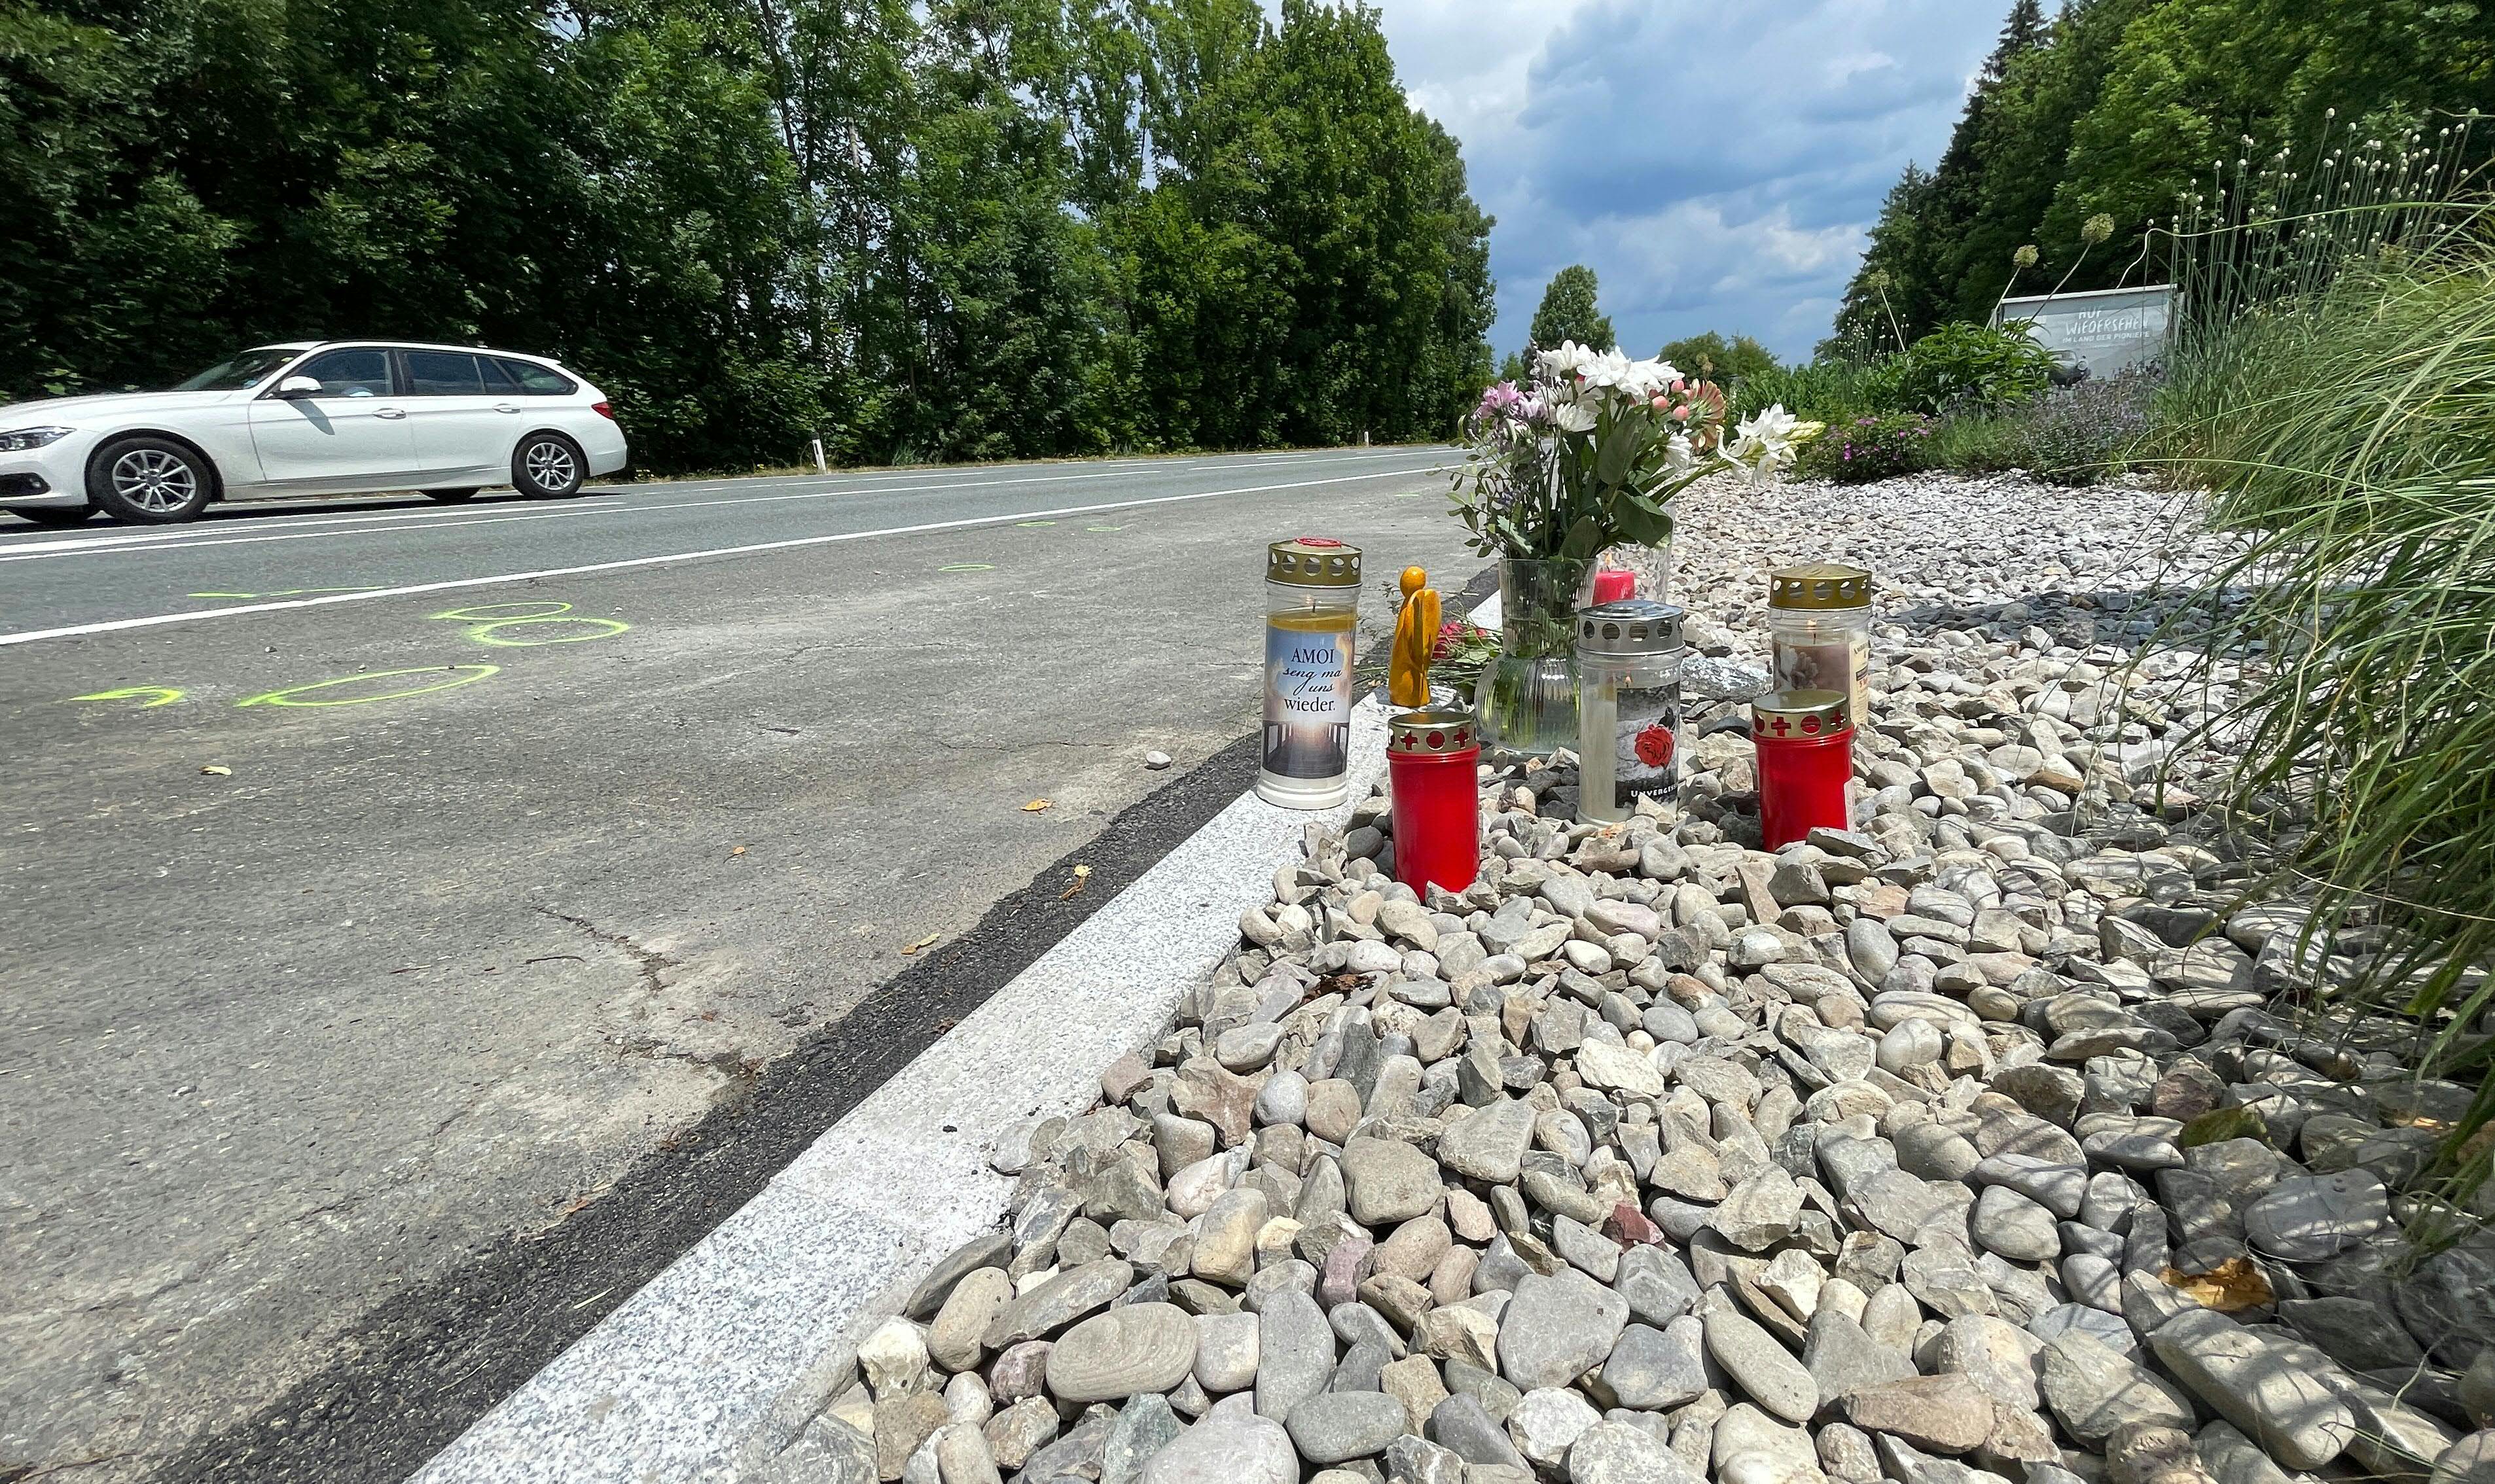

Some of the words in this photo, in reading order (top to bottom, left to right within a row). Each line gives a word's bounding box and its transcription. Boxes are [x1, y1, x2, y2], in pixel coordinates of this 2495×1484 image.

[1291, 648, 1335, 664] AMOI
[1283, 667, 1318, 696] seng
[1321, 669, 1342, 678] ma
[1308, 683, 1335, 692] uns
[1283, 696, 1335, 712] wieder.
